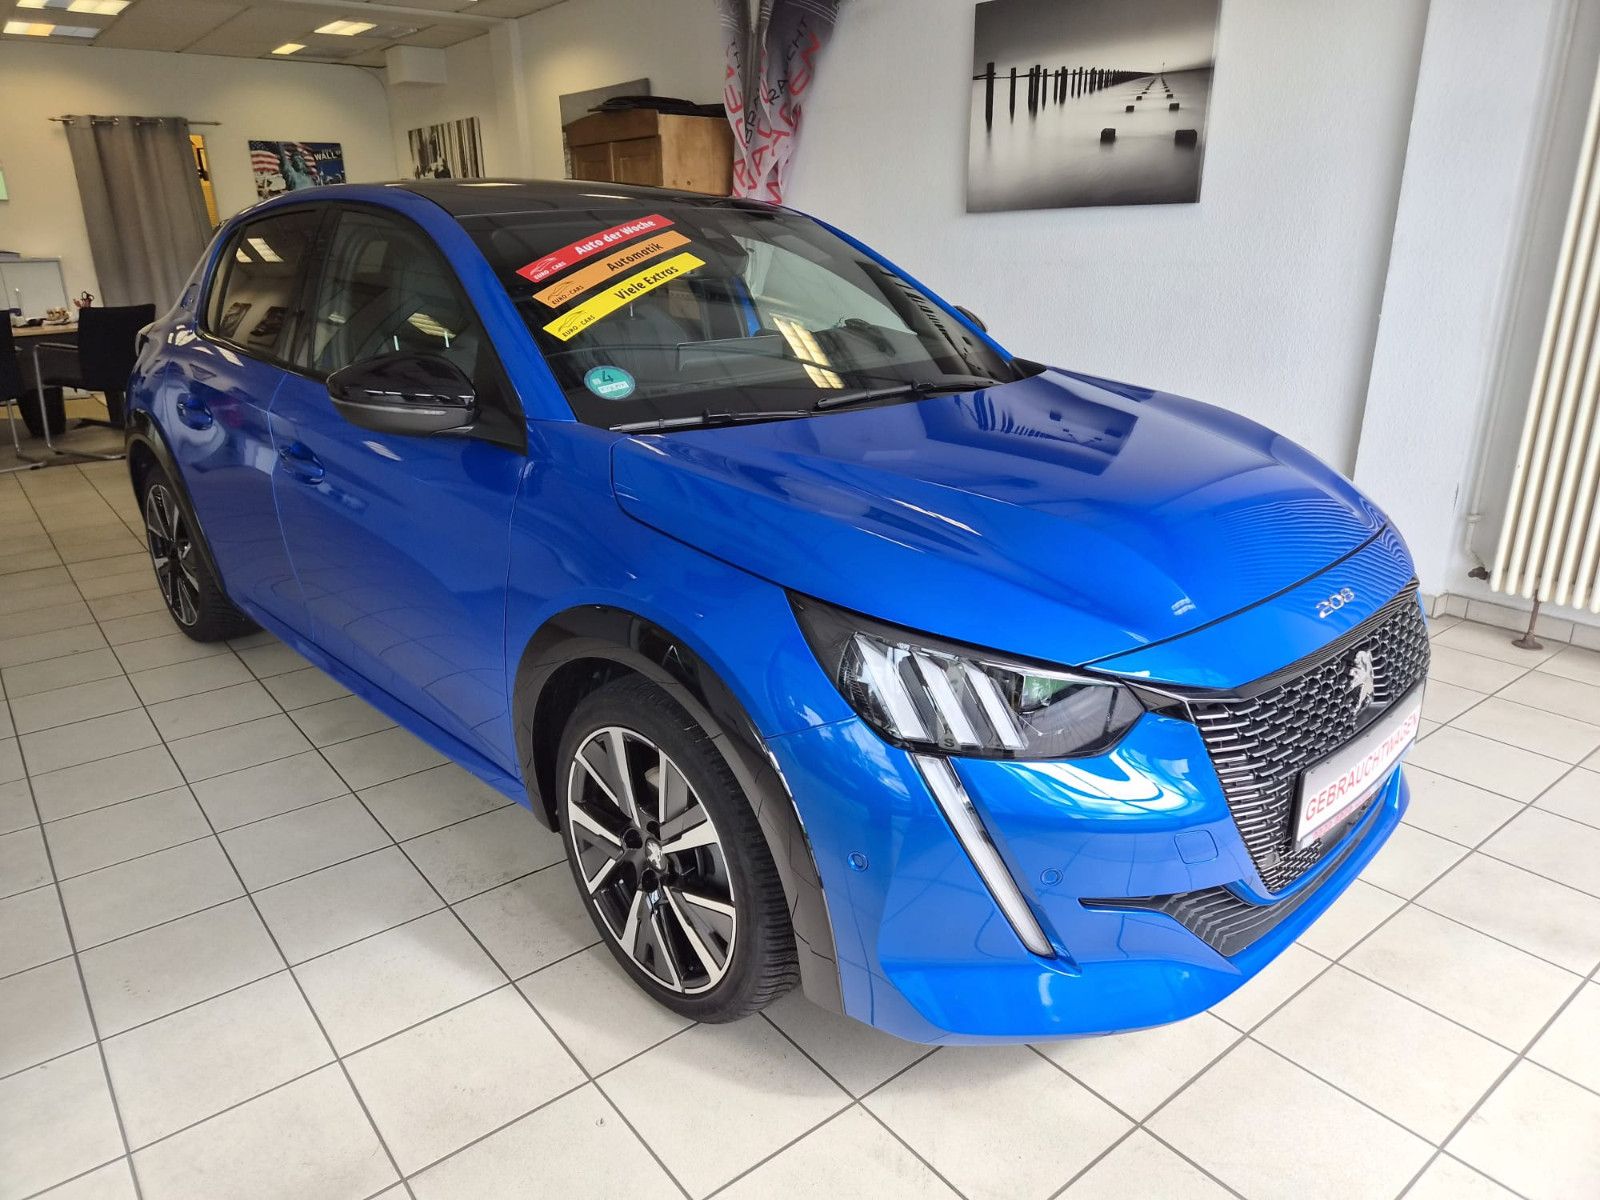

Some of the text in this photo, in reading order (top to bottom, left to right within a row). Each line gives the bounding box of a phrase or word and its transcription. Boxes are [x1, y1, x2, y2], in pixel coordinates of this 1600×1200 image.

[314, 152, 337, 161] WALL
[575, 220, 656, 255] Auto der Woche
[606, 243, 663, 272] Automatik
[551, 294, 567, 305] EURO
[569, 285, 584, 295] CARS
[614, 266, 679, 300] Viele Extras
[562, 325, 578, 337] EURO
[580, 314, 595, 326] CARS
[602, 370, 613, 382] 4
[1315, 587, 1354, 618] 208
